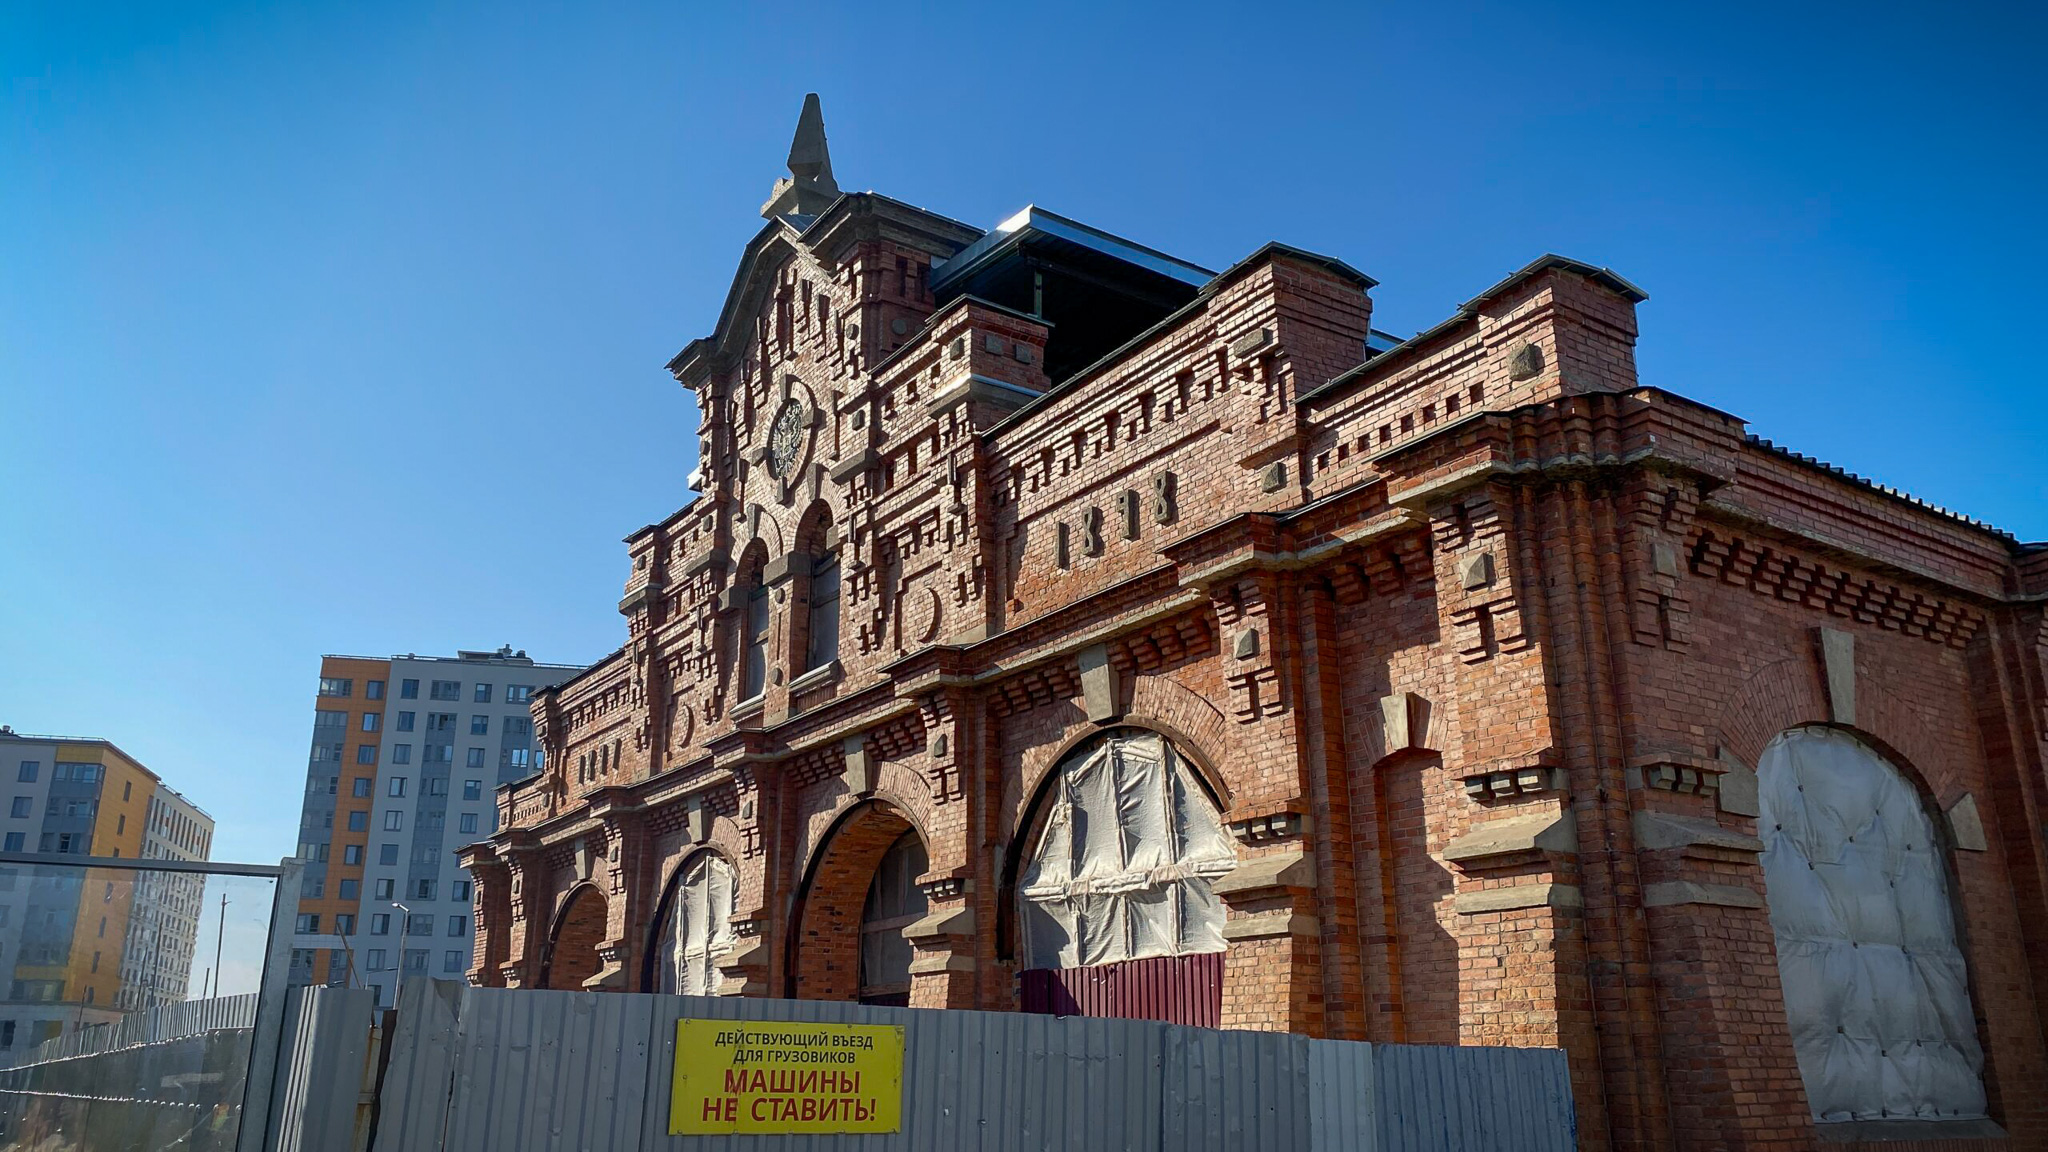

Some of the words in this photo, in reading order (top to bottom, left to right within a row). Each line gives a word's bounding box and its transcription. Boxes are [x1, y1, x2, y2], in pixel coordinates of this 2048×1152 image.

[1055, 471, 1176, 569] 1898
[715, 1029, 828, 1049] ДЕЙСТВУЮЩИЙ
[832, 1035, 874, 1050] ВЪЕЗД
[733, 1050, 763, 1065] ДЛЯ
[767, 1050, 856, 1064] ГРУЗОВИКОВ
[724, 1069, 860, 1094] МАШИНЫ
[702, 1097, 737, 1122] НЕ
[751, 1097, 877, 1122] СТАВИТЬ!
